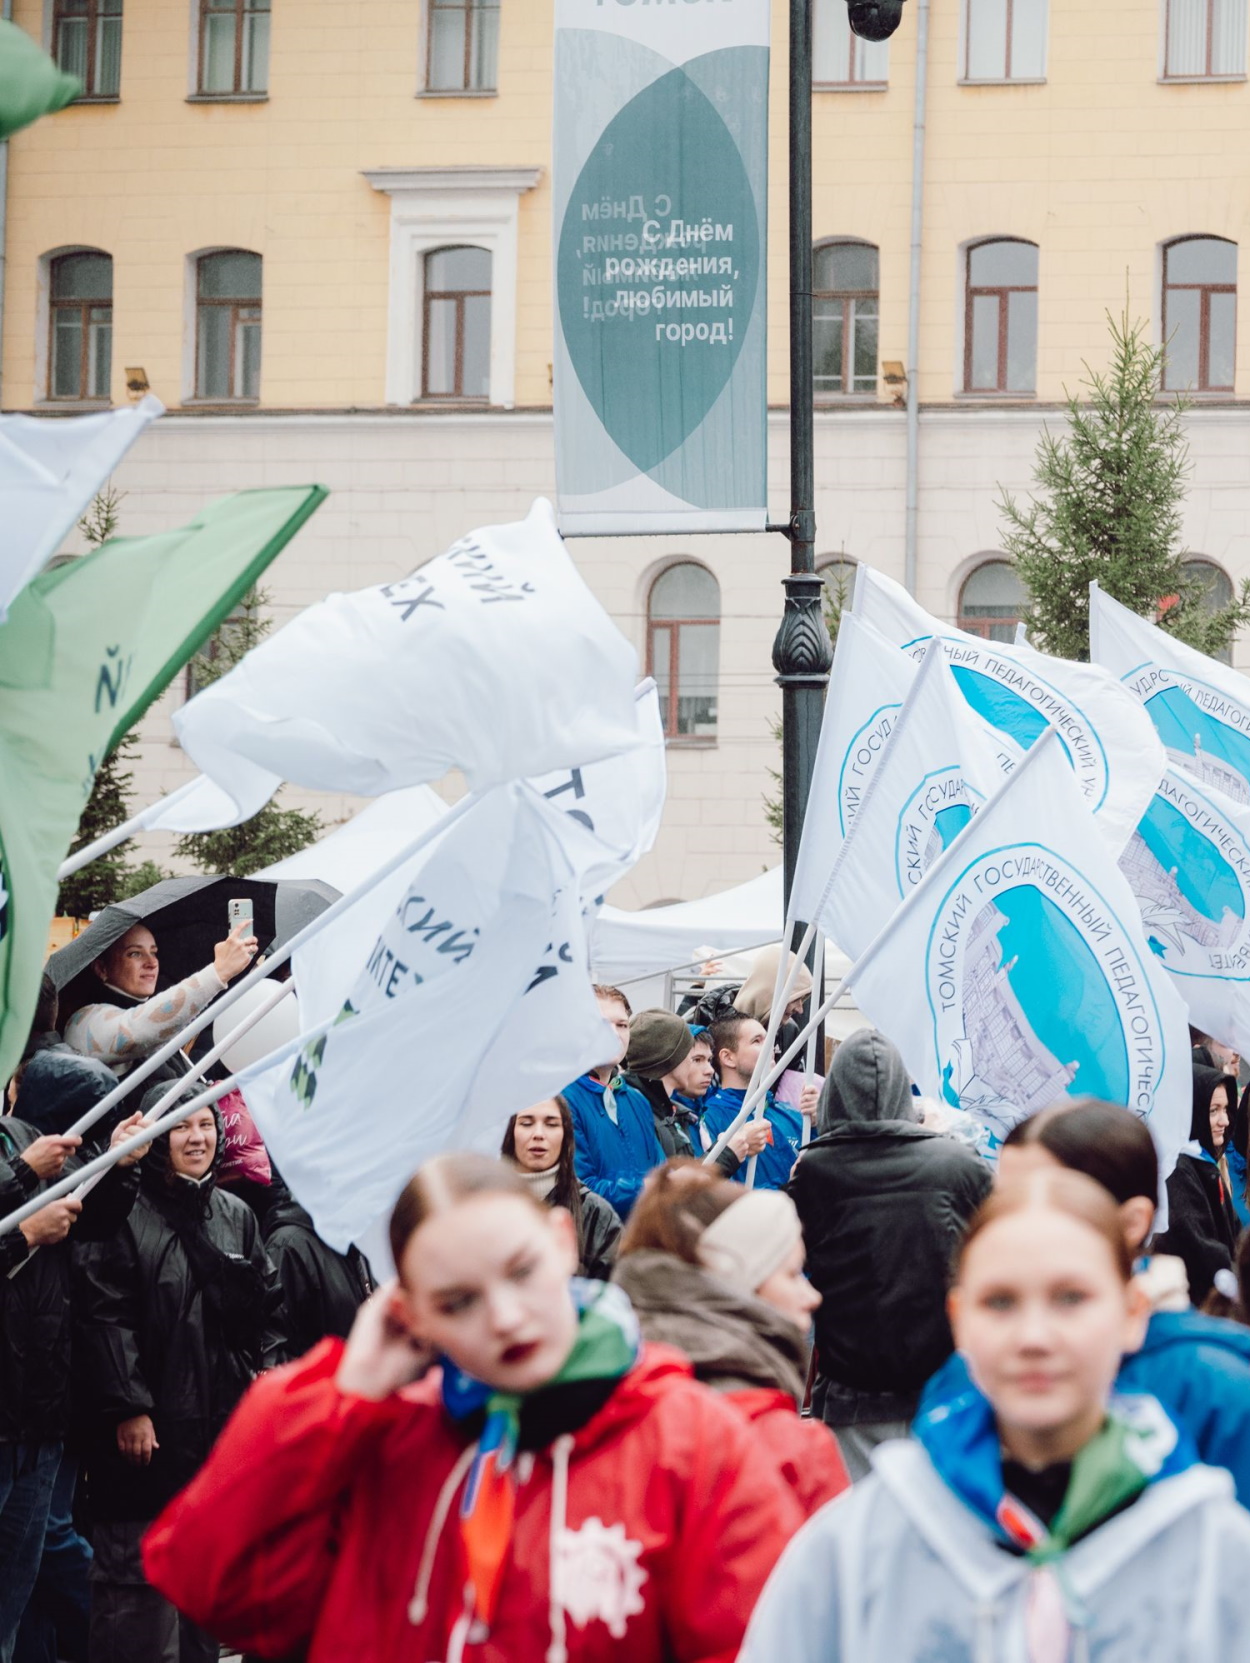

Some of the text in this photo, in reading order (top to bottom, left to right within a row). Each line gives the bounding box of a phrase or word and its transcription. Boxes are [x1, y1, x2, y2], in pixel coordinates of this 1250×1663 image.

[643, 218, 733, 247] С Днём
[606, 256, 739, 280] рождения,
[614, 284, 733, 308] любимый
[655, 318, 733, 346] город!
[985, 658, 1099, 768] ПЕДАГОГИЧЕСКИЙ
[936, 892, 974, 1014] ТОМСКИЙ
[973, 855, 1112, 943] ГОСУДАРСТВЕННЫЙ
